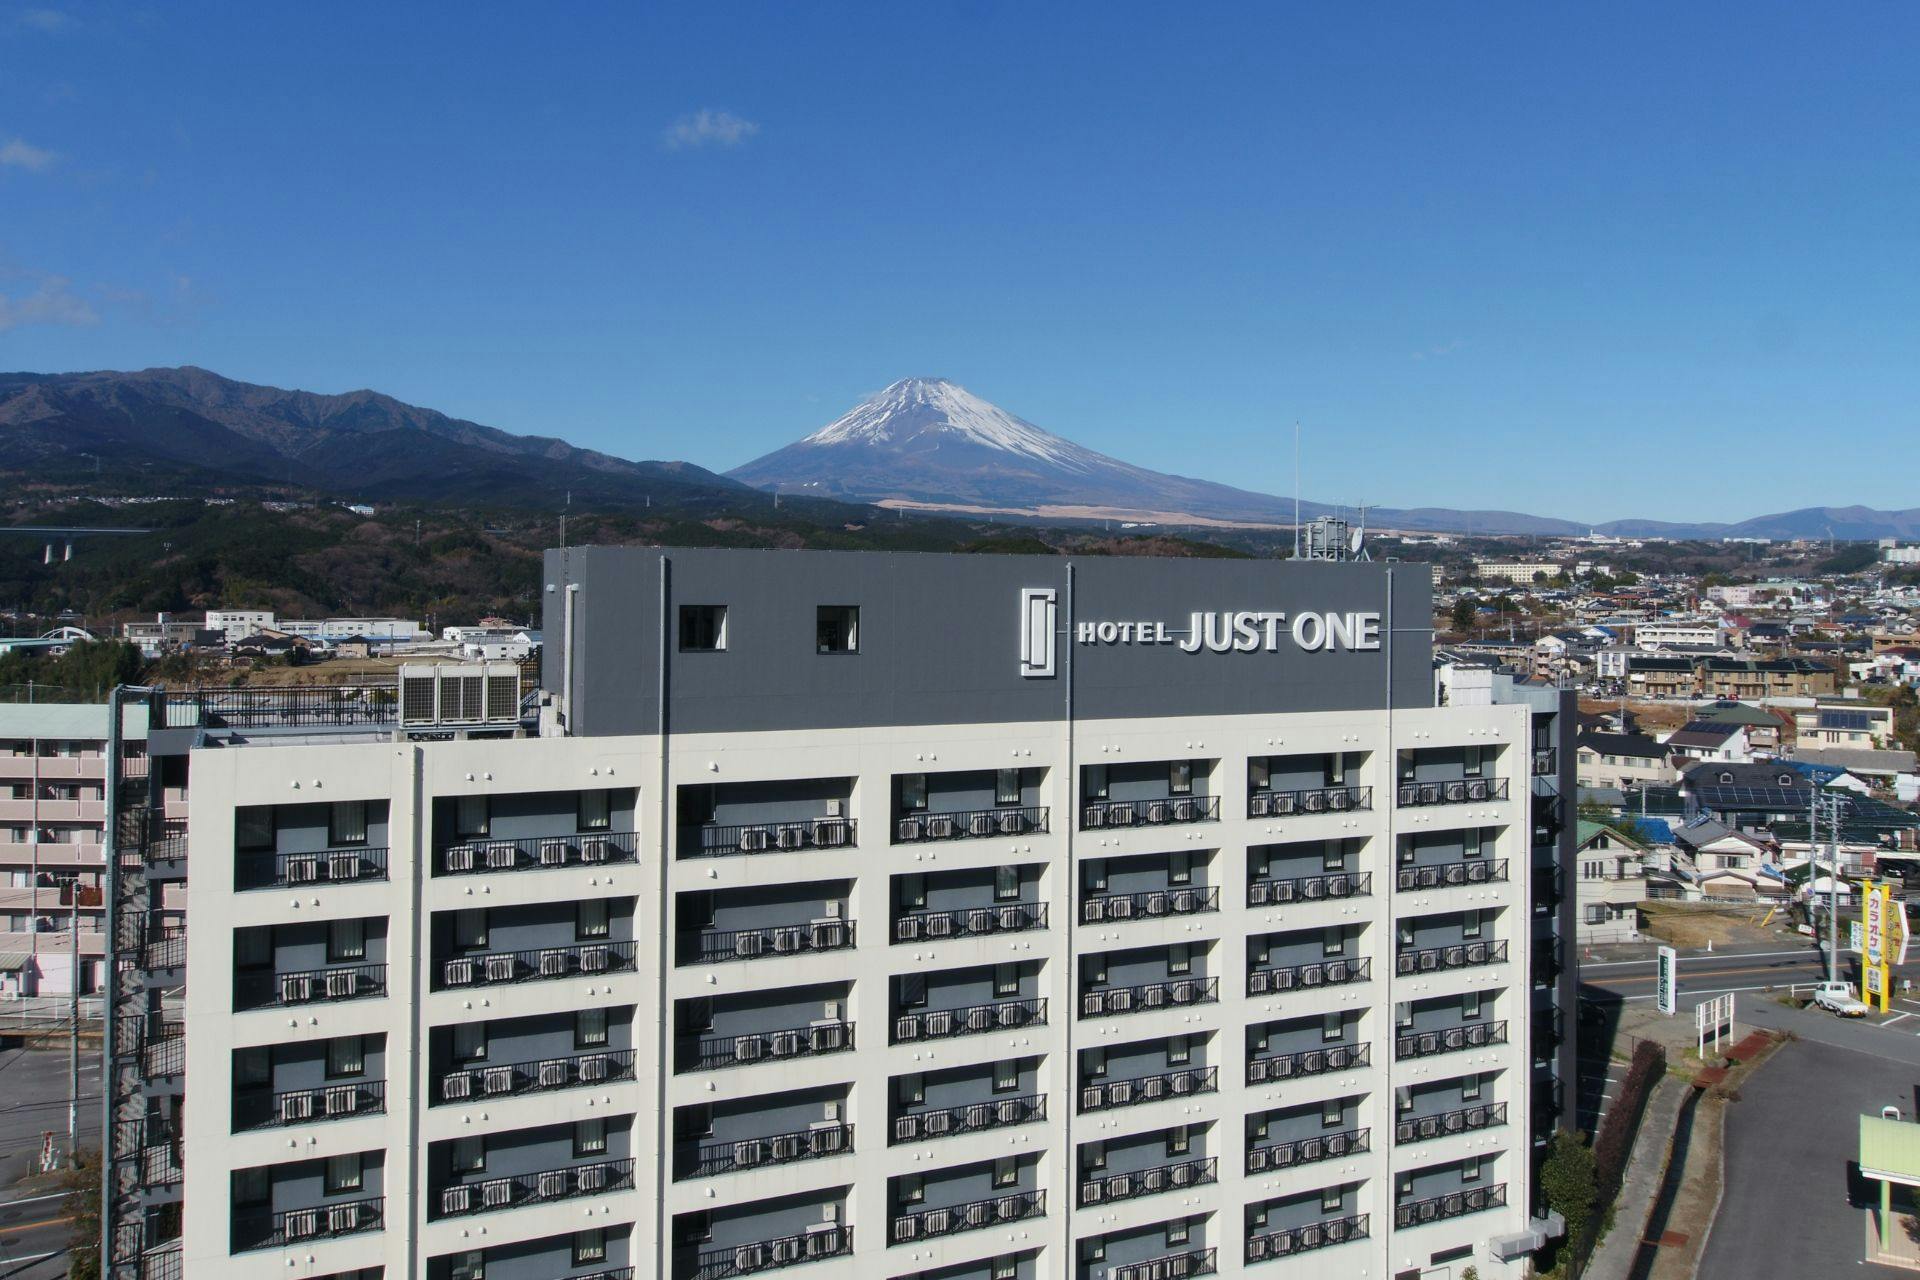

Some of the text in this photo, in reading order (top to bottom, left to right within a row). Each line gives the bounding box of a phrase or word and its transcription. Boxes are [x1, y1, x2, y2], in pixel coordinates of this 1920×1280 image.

[1078, 611, 1380, 652] HOTEL JUST ONE
[1869, 898, 1879, 948] カラオケ
